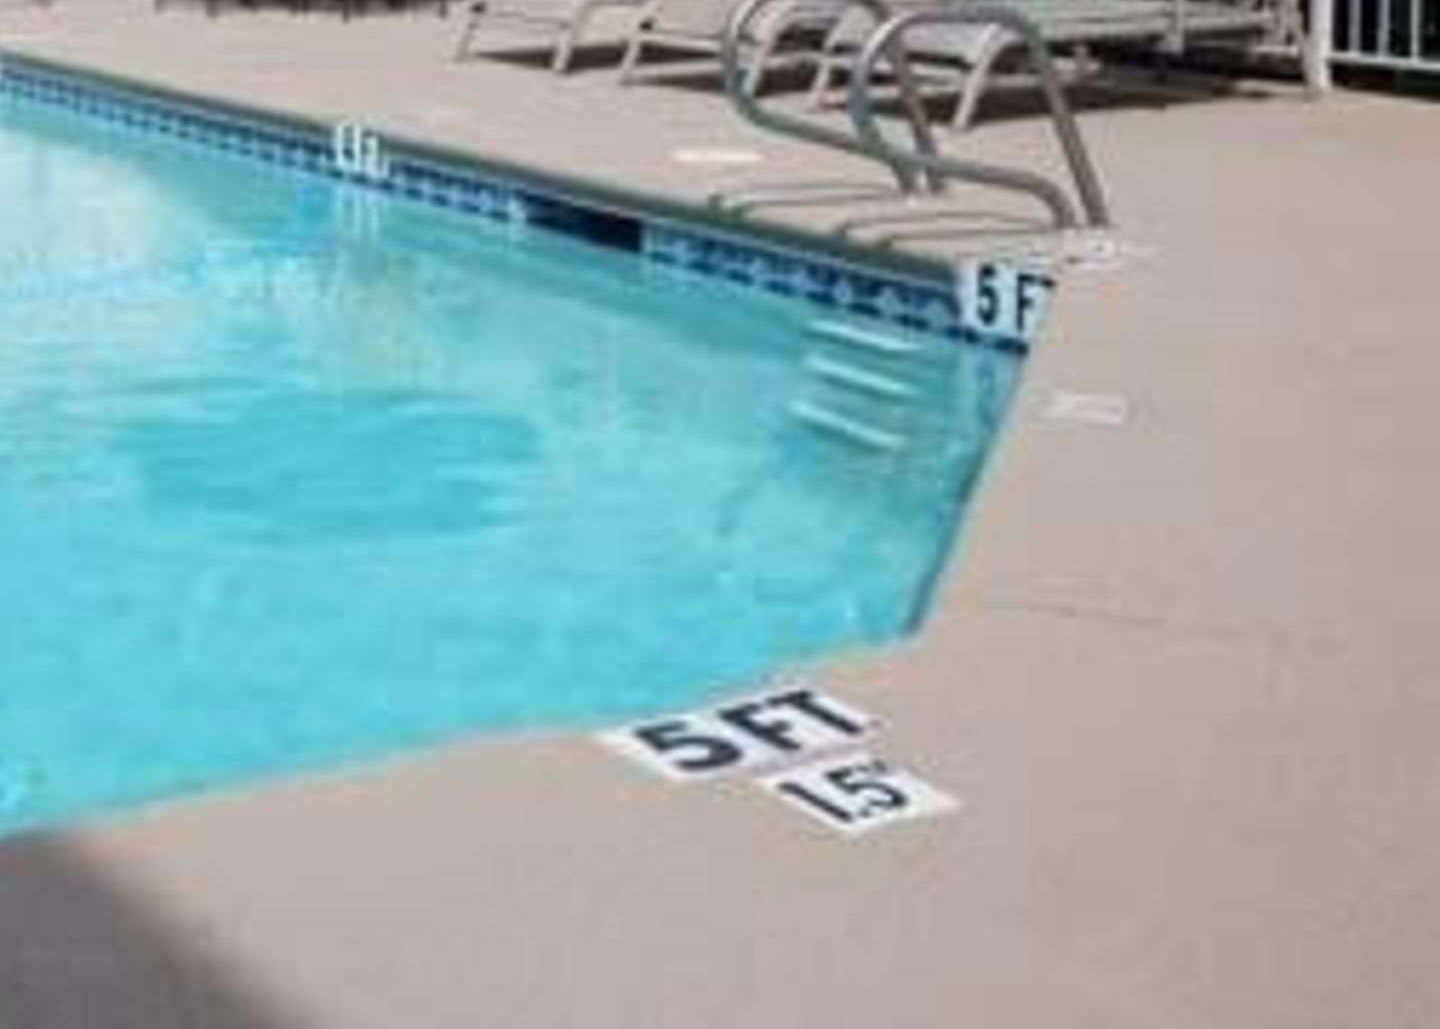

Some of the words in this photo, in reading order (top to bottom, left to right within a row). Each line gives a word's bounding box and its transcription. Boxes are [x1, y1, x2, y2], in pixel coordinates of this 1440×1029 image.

[976, 262, 1000, 327] 5
[633, 719, 744, 772] 5
[716, 687, 862, 753] FT
